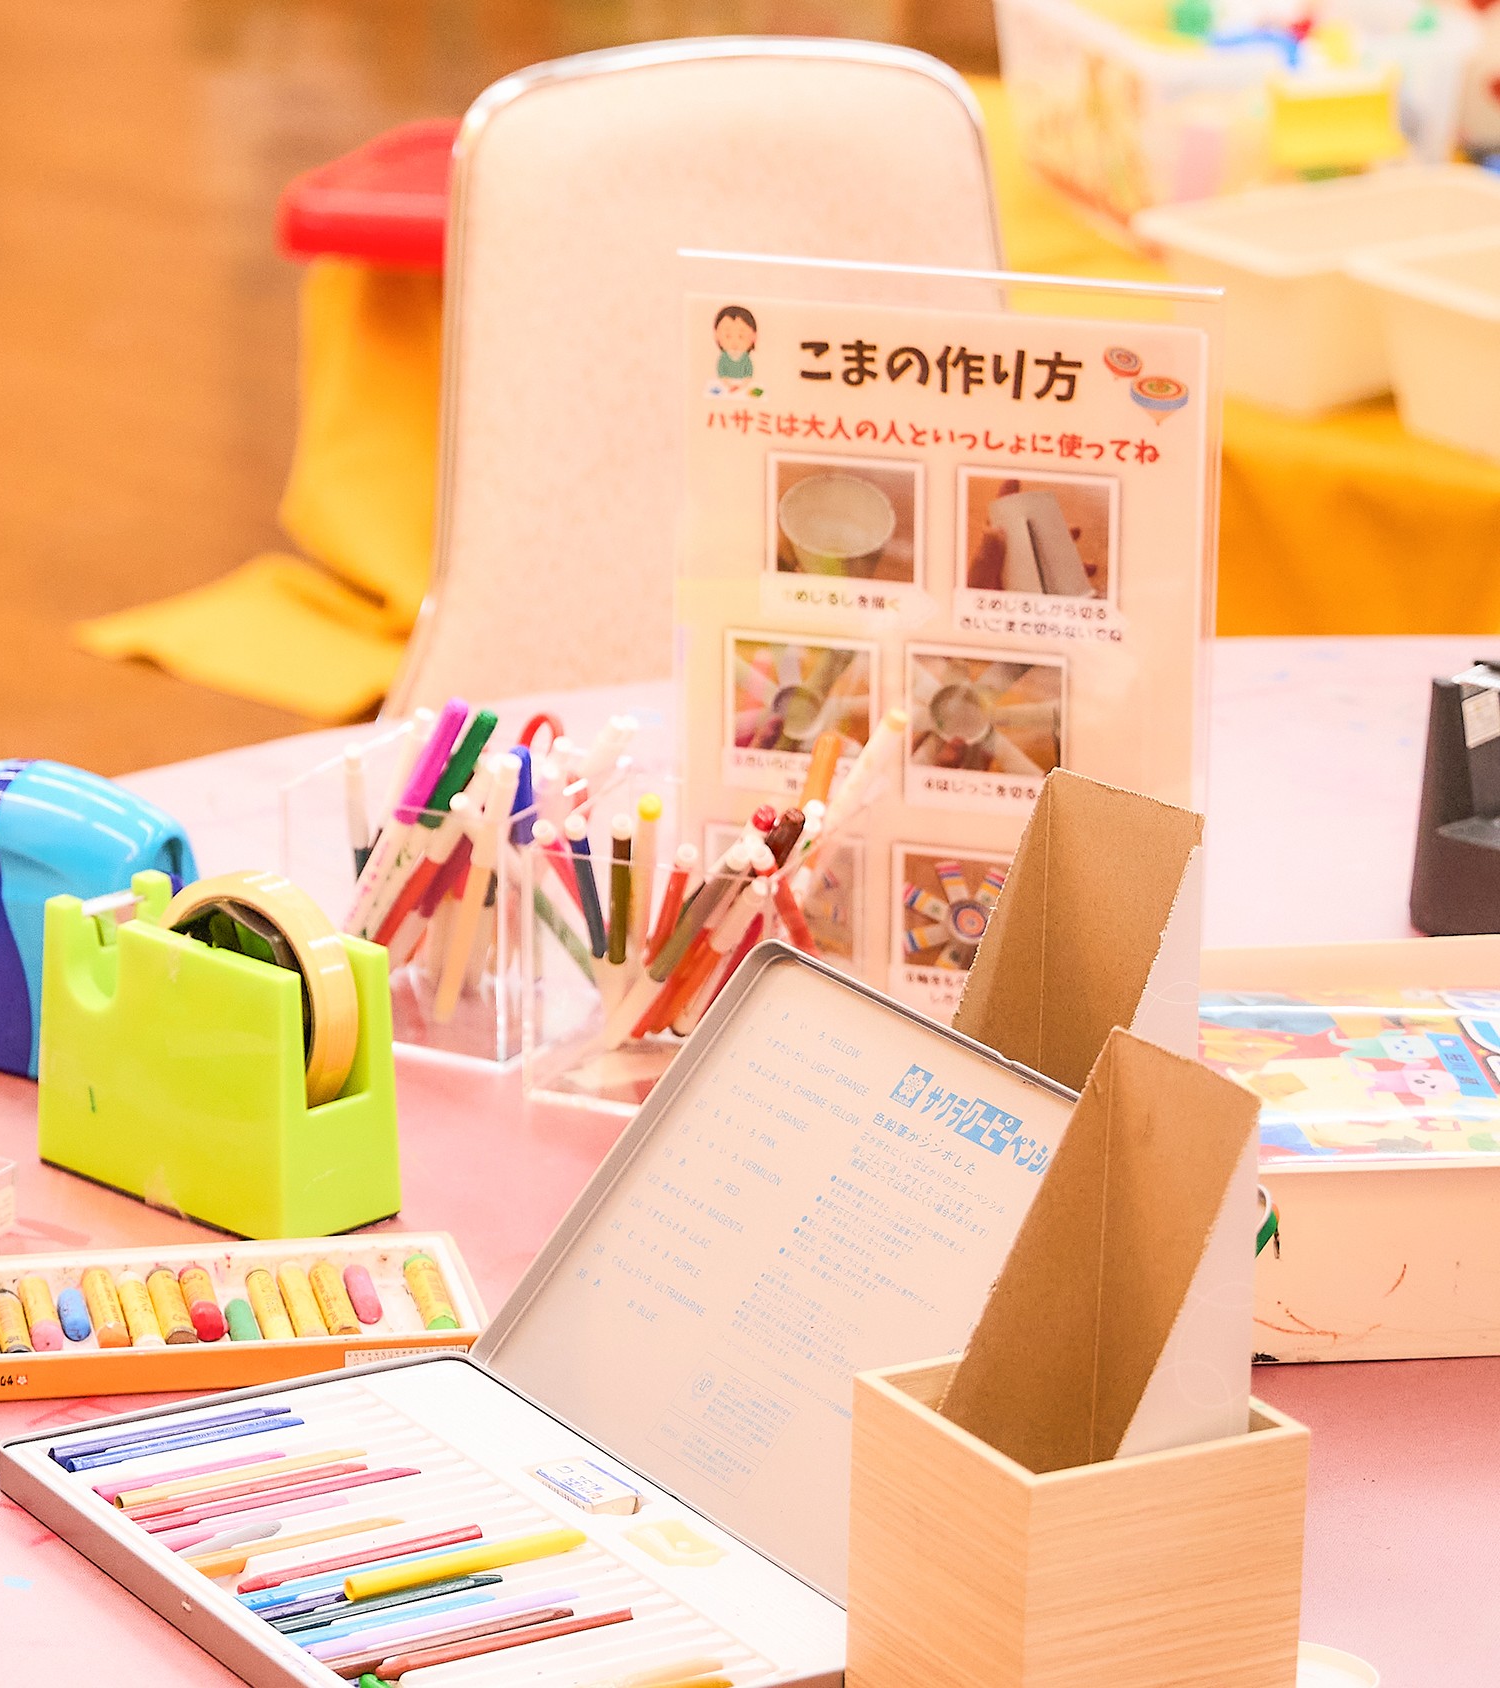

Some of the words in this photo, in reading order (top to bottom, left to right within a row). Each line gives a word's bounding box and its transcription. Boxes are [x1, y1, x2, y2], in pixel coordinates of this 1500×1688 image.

[799, 338, 1082, 401] こまの作り方
[707, 410, 1160, 465] ハサミは大人の人といっしょに使ってね
[827, 1036, 862, 1060] YELLOW
[809, 1059, 836, 1079] LIGHT
[834, 1073, 870, 1097] ORANGE
[774, 1108, 810, 1132] ORANGE
[792, 1084, 828, 1108] CHROME
[826, 1102, 862, 1127] YELLOW
[756, 1132, 778, 1149] PINK
[871, 1110, 979, 1175] 色鉛筆がシンポした
[740, 1156, 783, 1187] VERMILION
[722, 1181, 741, 1197] RED
[704, 1205, 745, 1234] MAGENTA
[687, 1230, 712, 1249] LILAC
[670, 1255, 702, 1279] PURPLE
[635, 1303, 659, 1322] BLUE
[653, 1279, 707, 1317] ULTRAMARINE
